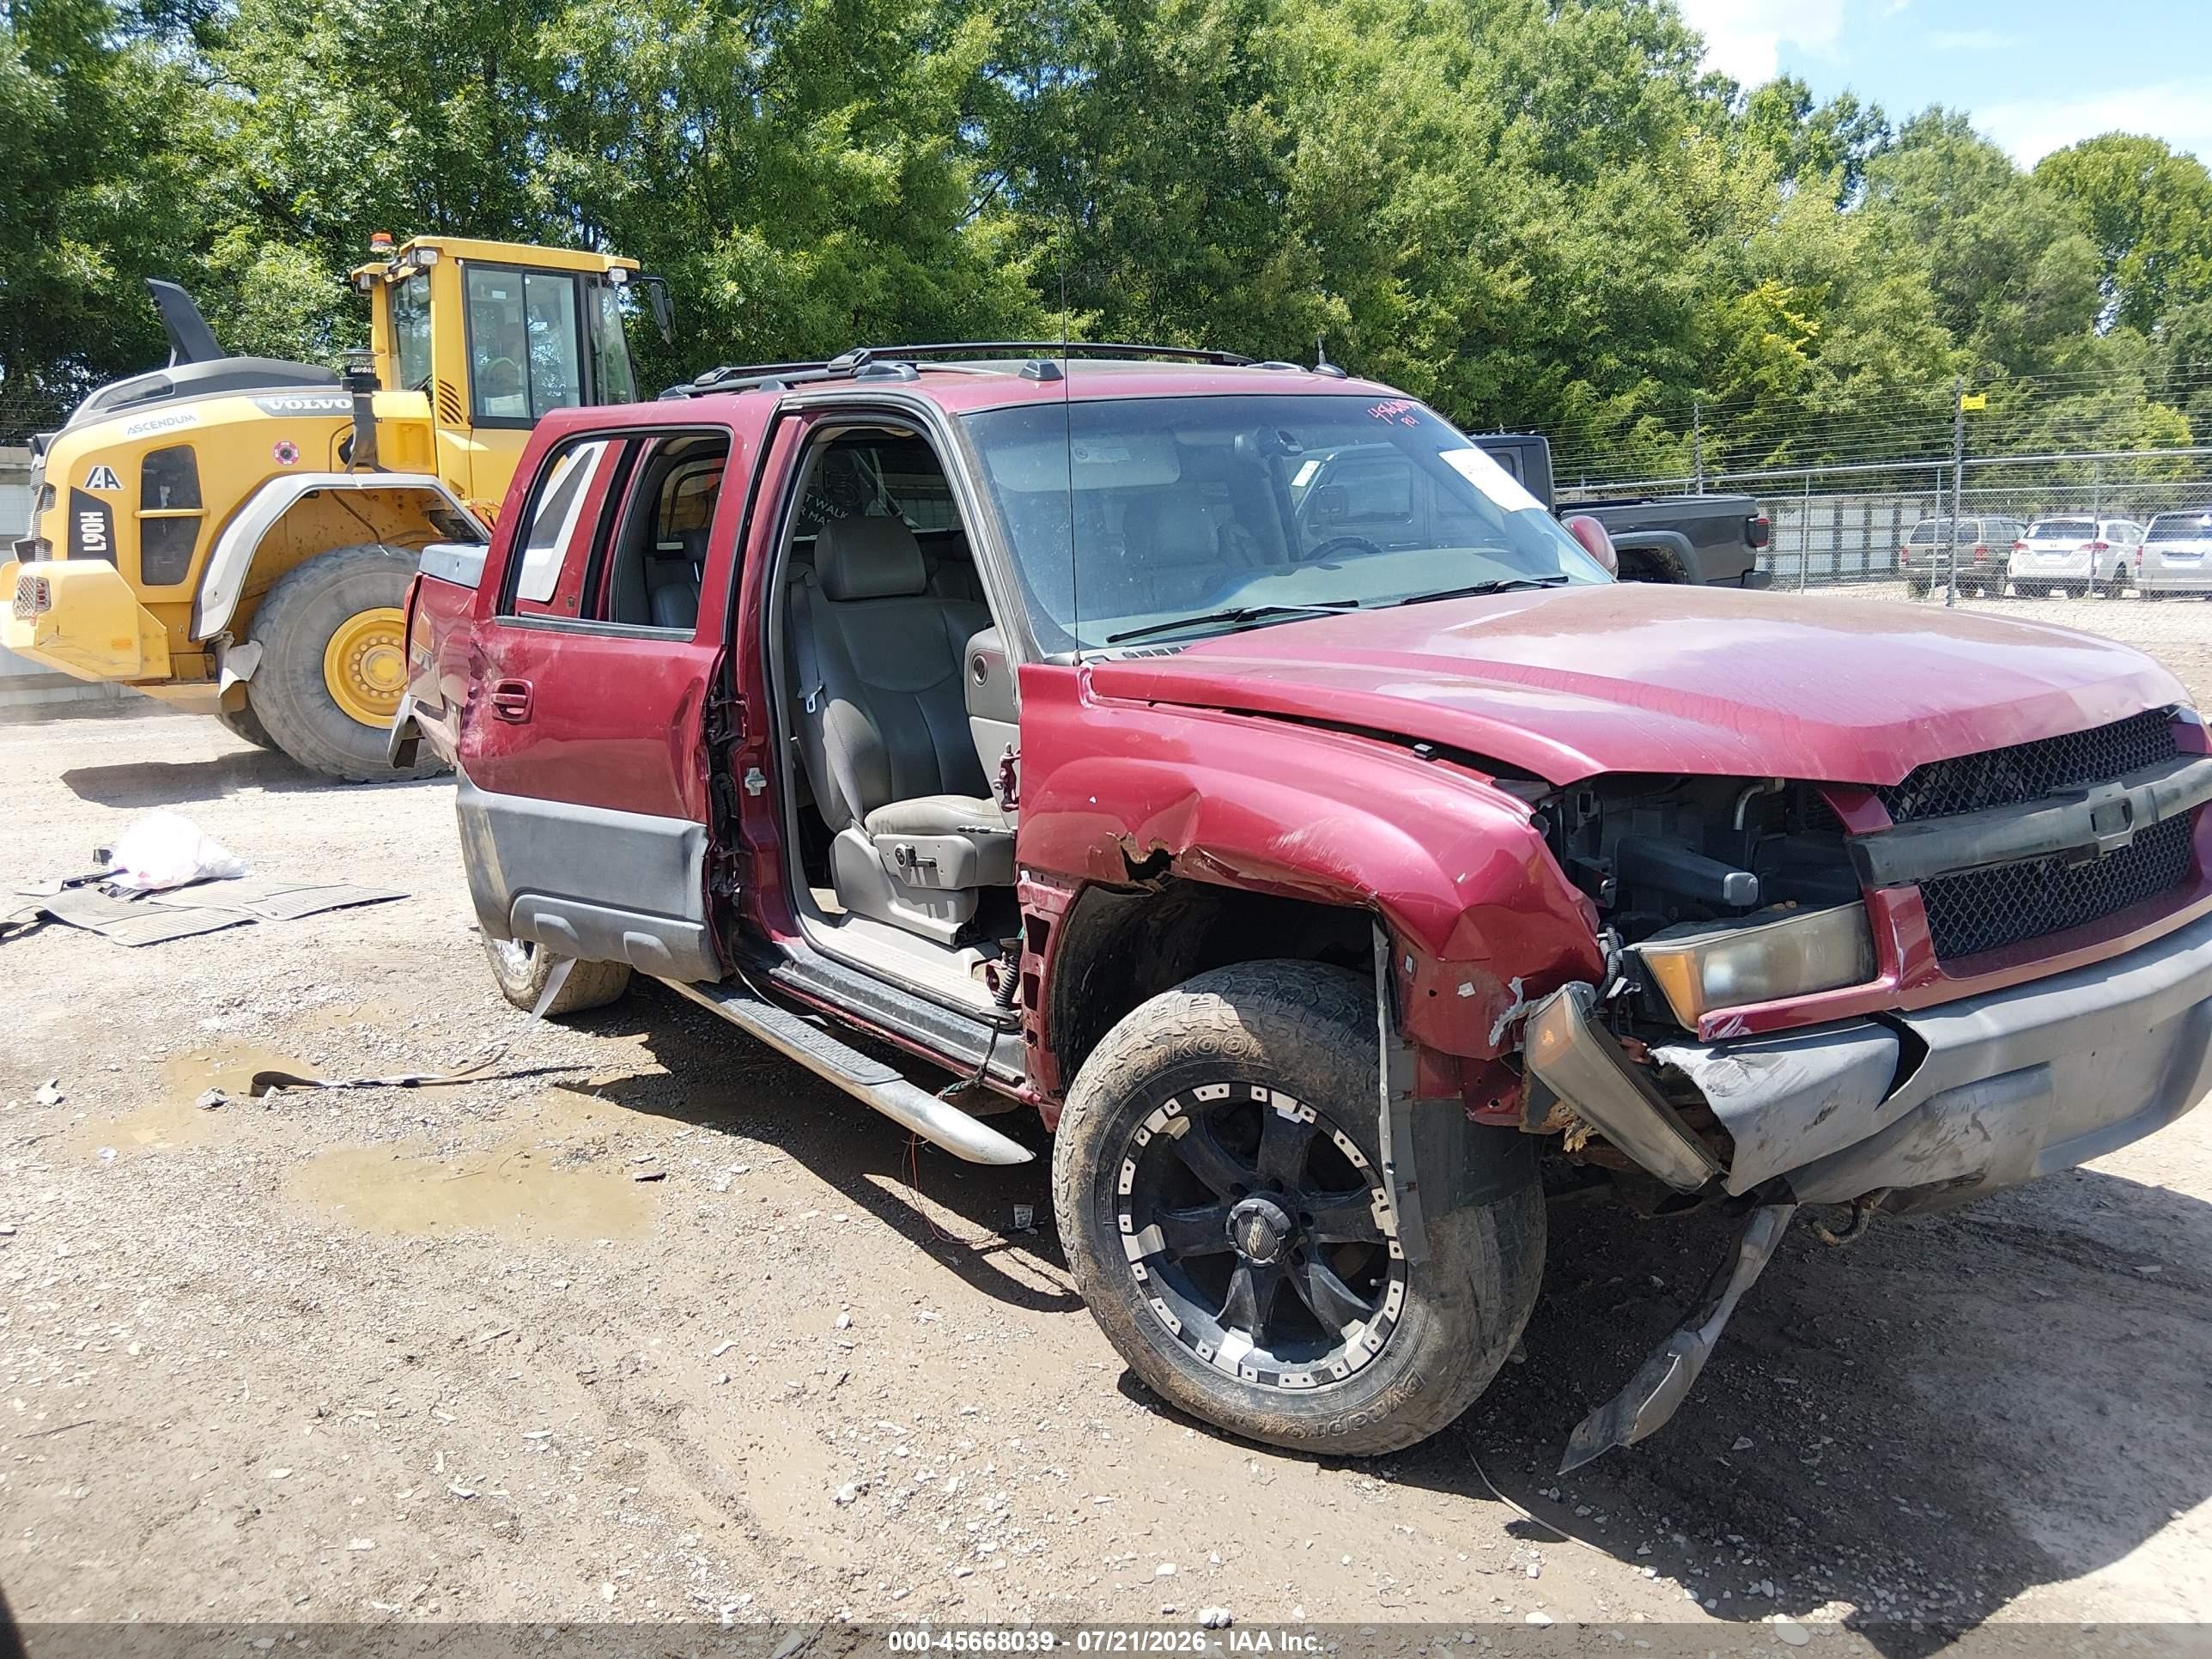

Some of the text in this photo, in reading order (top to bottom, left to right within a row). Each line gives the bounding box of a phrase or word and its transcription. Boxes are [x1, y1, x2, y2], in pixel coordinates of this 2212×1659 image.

[264, 398, 353, 410] VOLVO
[127, 414, 198, 435] ASCENDUM
[816, 498, 849, 520] WALK
[80, 512, 107, 551] L90H
